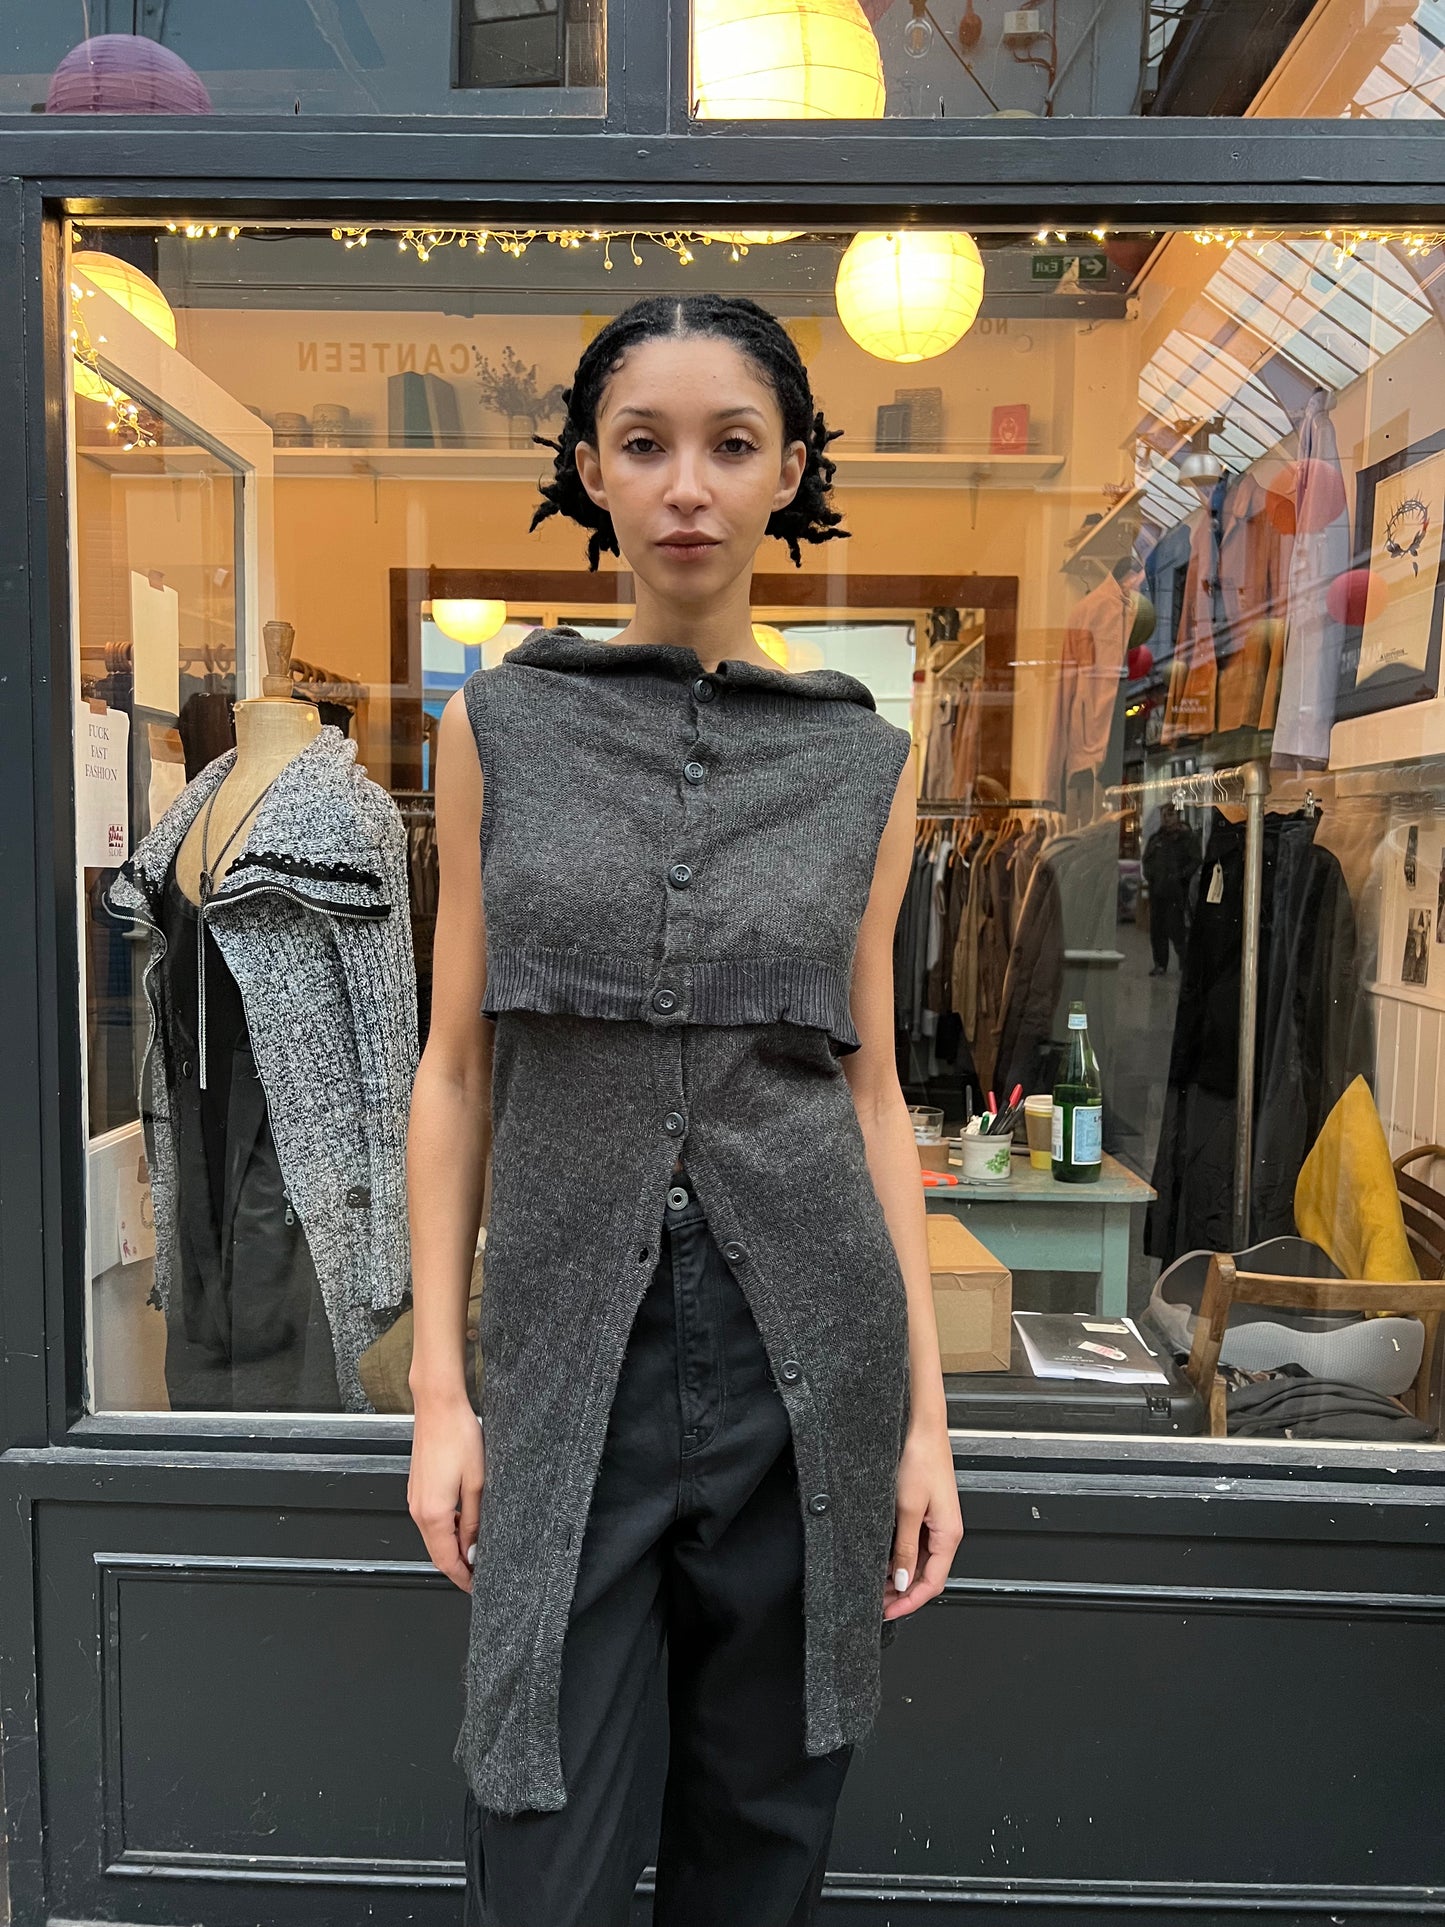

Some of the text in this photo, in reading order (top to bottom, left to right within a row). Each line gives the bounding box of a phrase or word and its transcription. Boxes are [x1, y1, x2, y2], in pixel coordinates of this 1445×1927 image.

[88, 723, 110, 741] FUCK
[90, 744, 108, 760] FAST
[85, 763, 118, 781] FASHION
